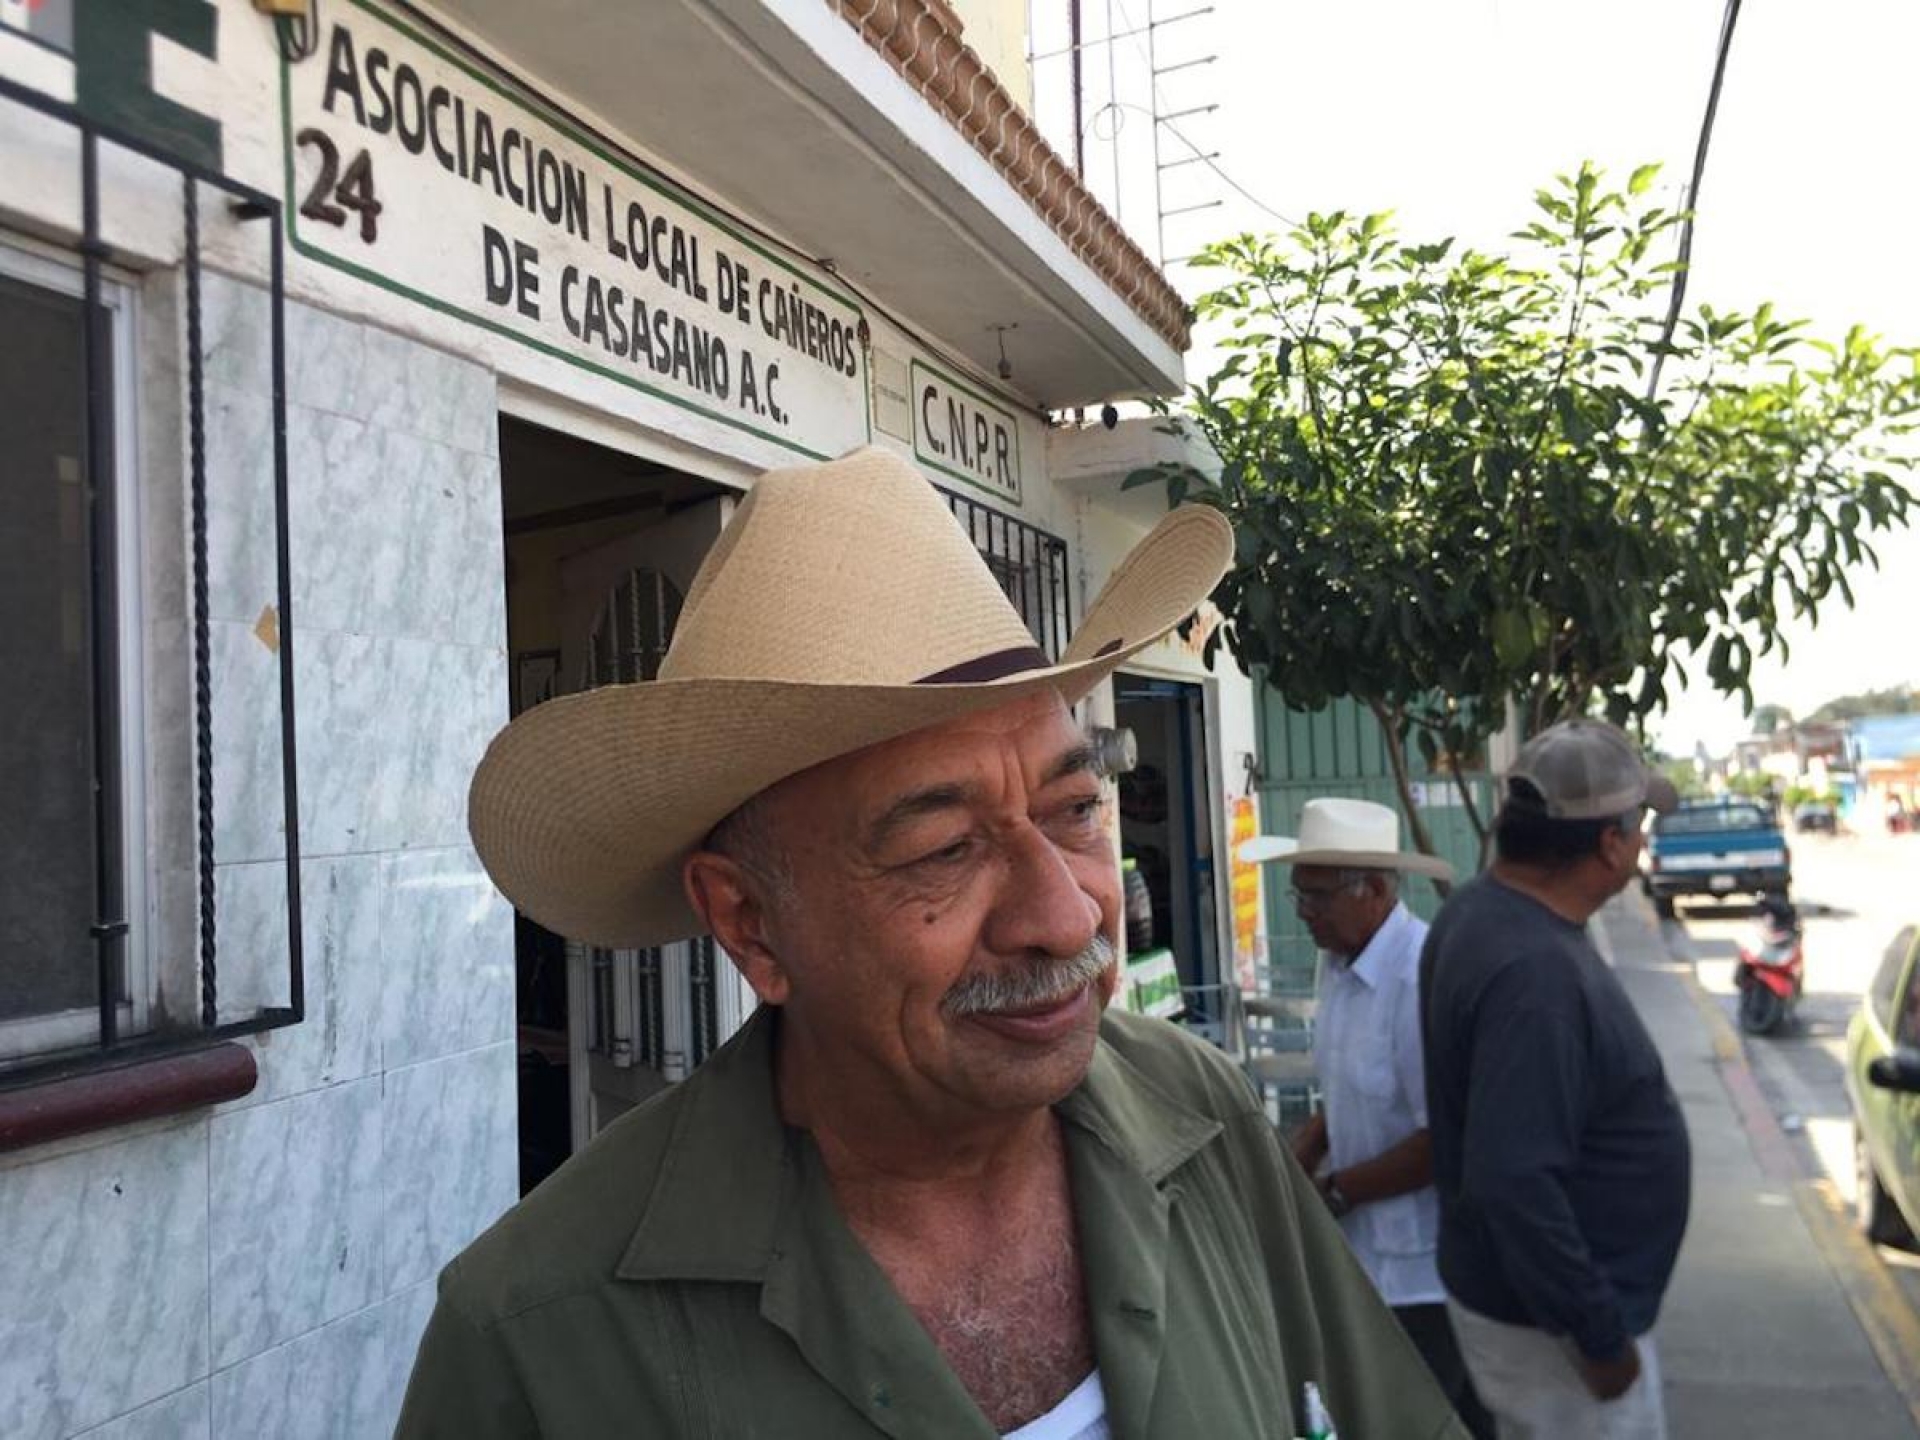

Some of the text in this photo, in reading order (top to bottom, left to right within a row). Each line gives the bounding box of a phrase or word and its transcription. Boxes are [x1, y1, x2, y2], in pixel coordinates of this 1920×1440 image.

[296, 128, 382, 245] 24
[322, 23, 856, 377] ASOCIACION LOCAL DE CAÑEROS
[482, 223, 788, 425] DE CASASANO A.C.
[922, 384, 1016, 491] C.N.P.R.
